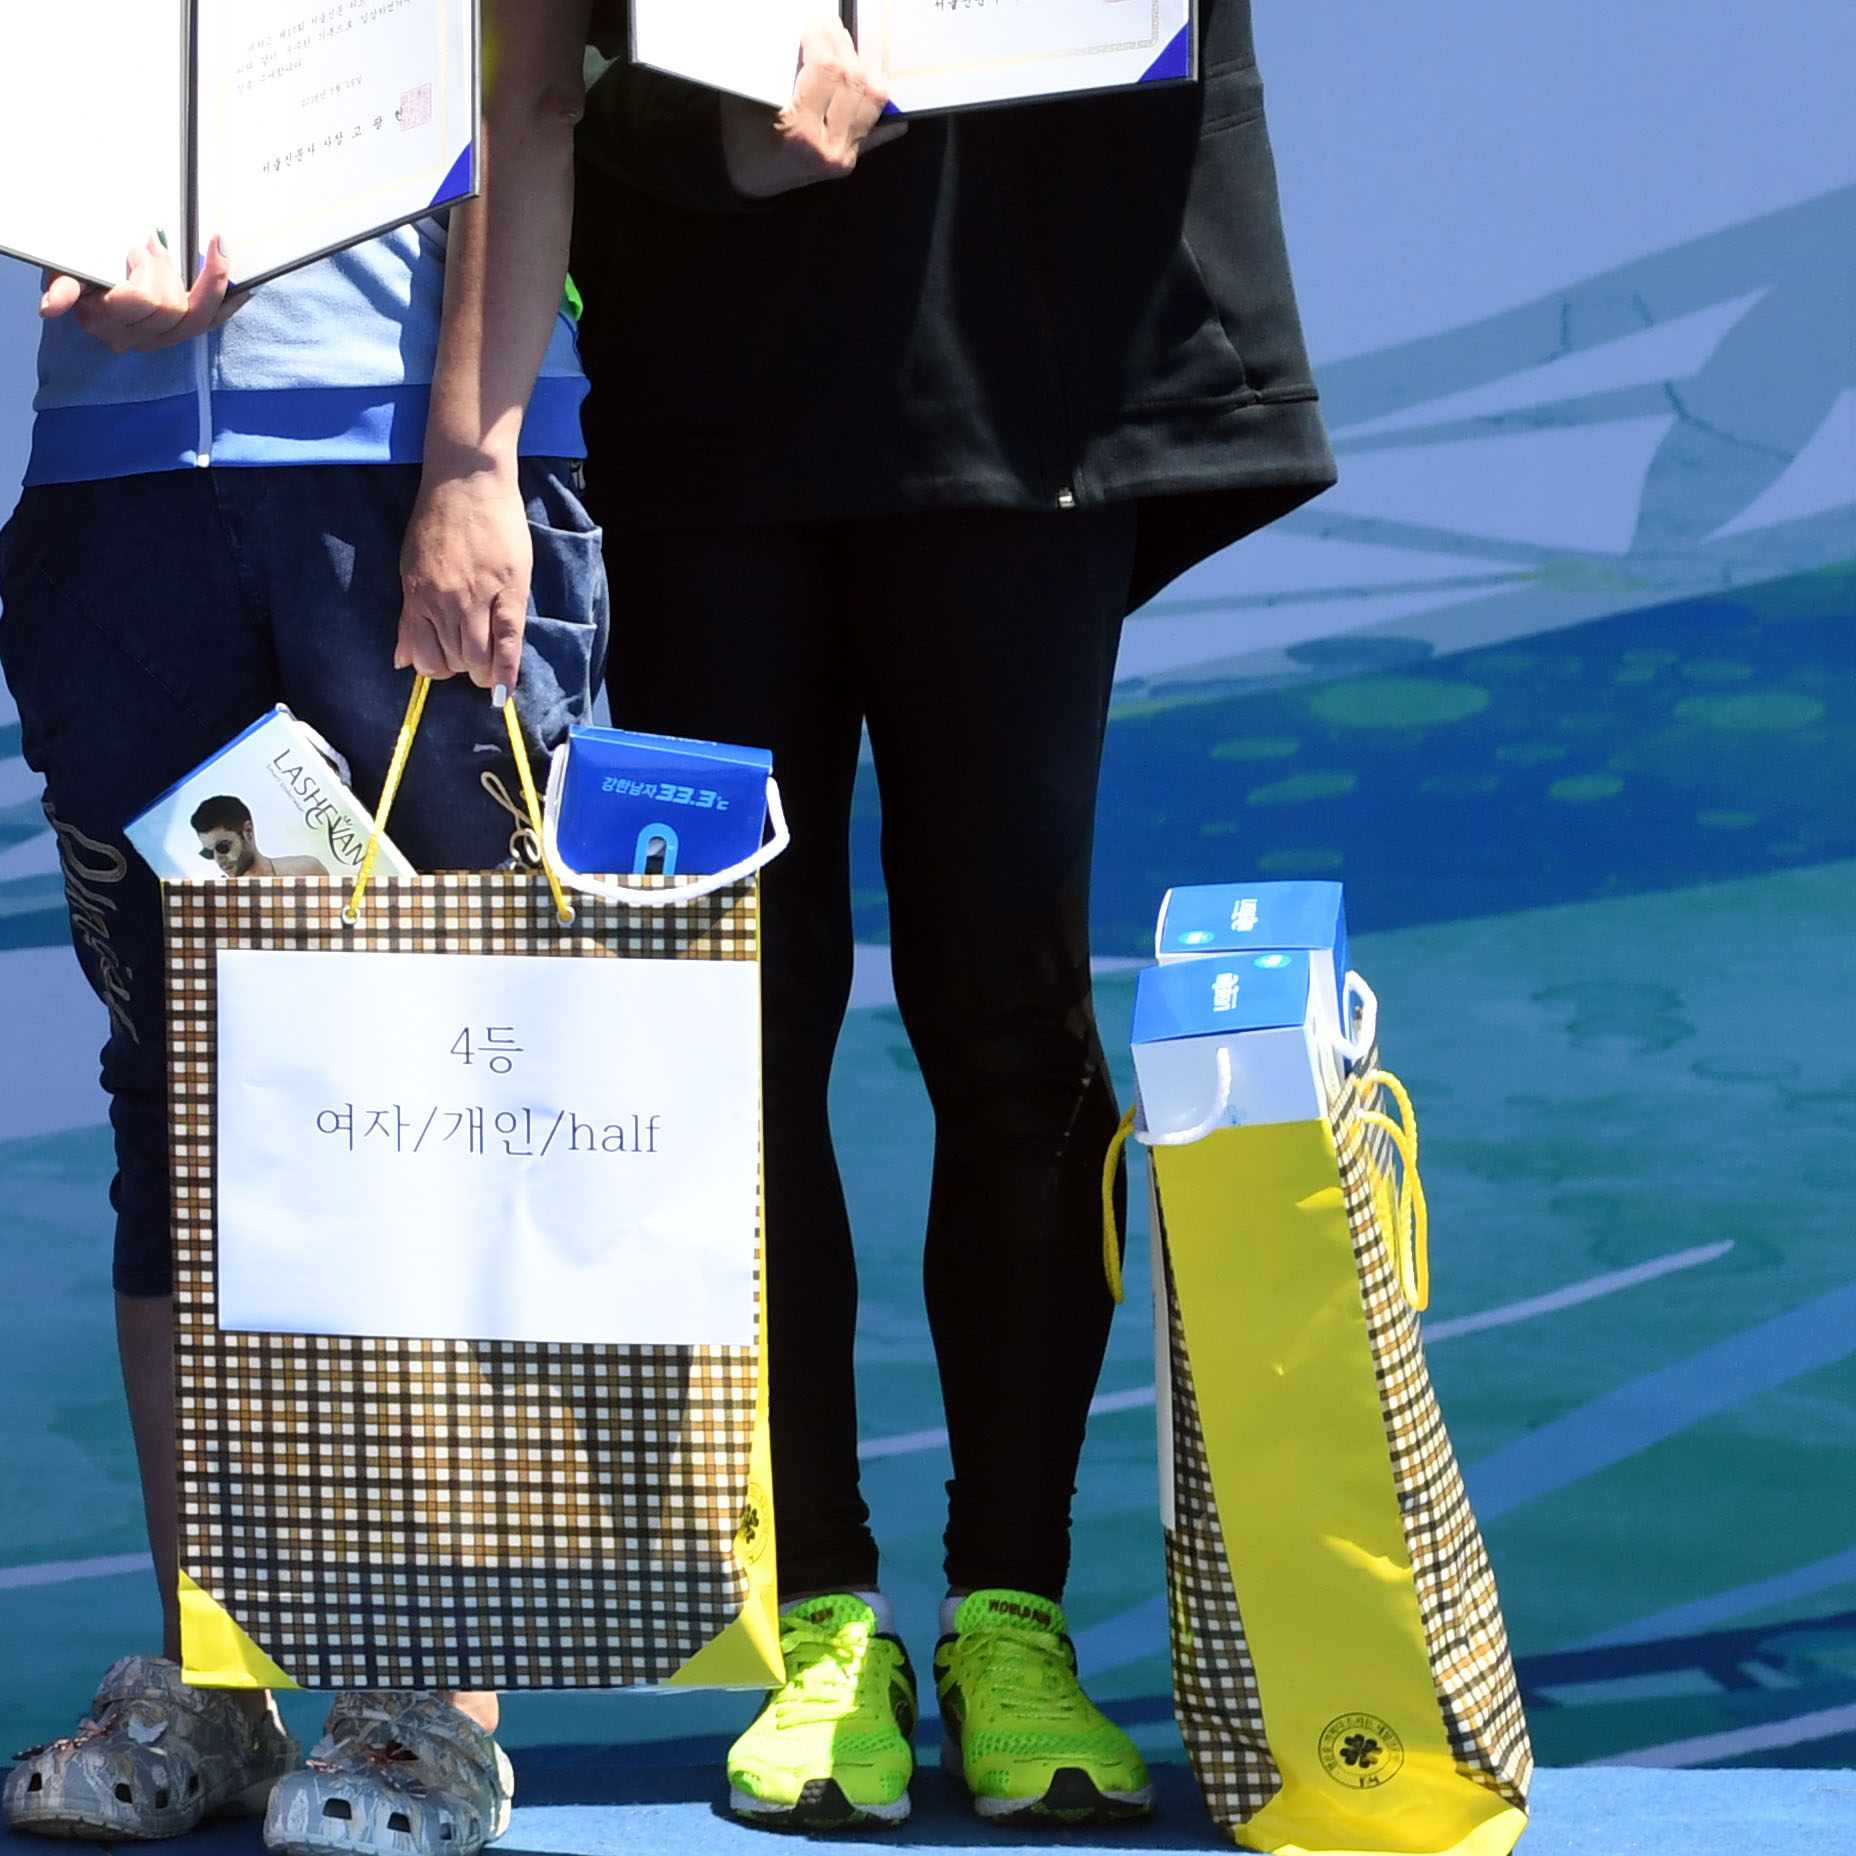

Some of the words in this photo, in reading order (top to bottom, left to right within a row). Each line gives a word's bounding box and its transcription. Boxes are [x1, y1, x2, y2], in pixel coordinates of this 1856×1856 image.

[351, 125, 362, 139] 고
[273, 748, 368, 866] LASHEVAN
[450, 1027, 524, 1074] 4등
[316, 1102, 662, 1157] 여자/개인/half
[989, 1599, 1032, 1619] WORLD
